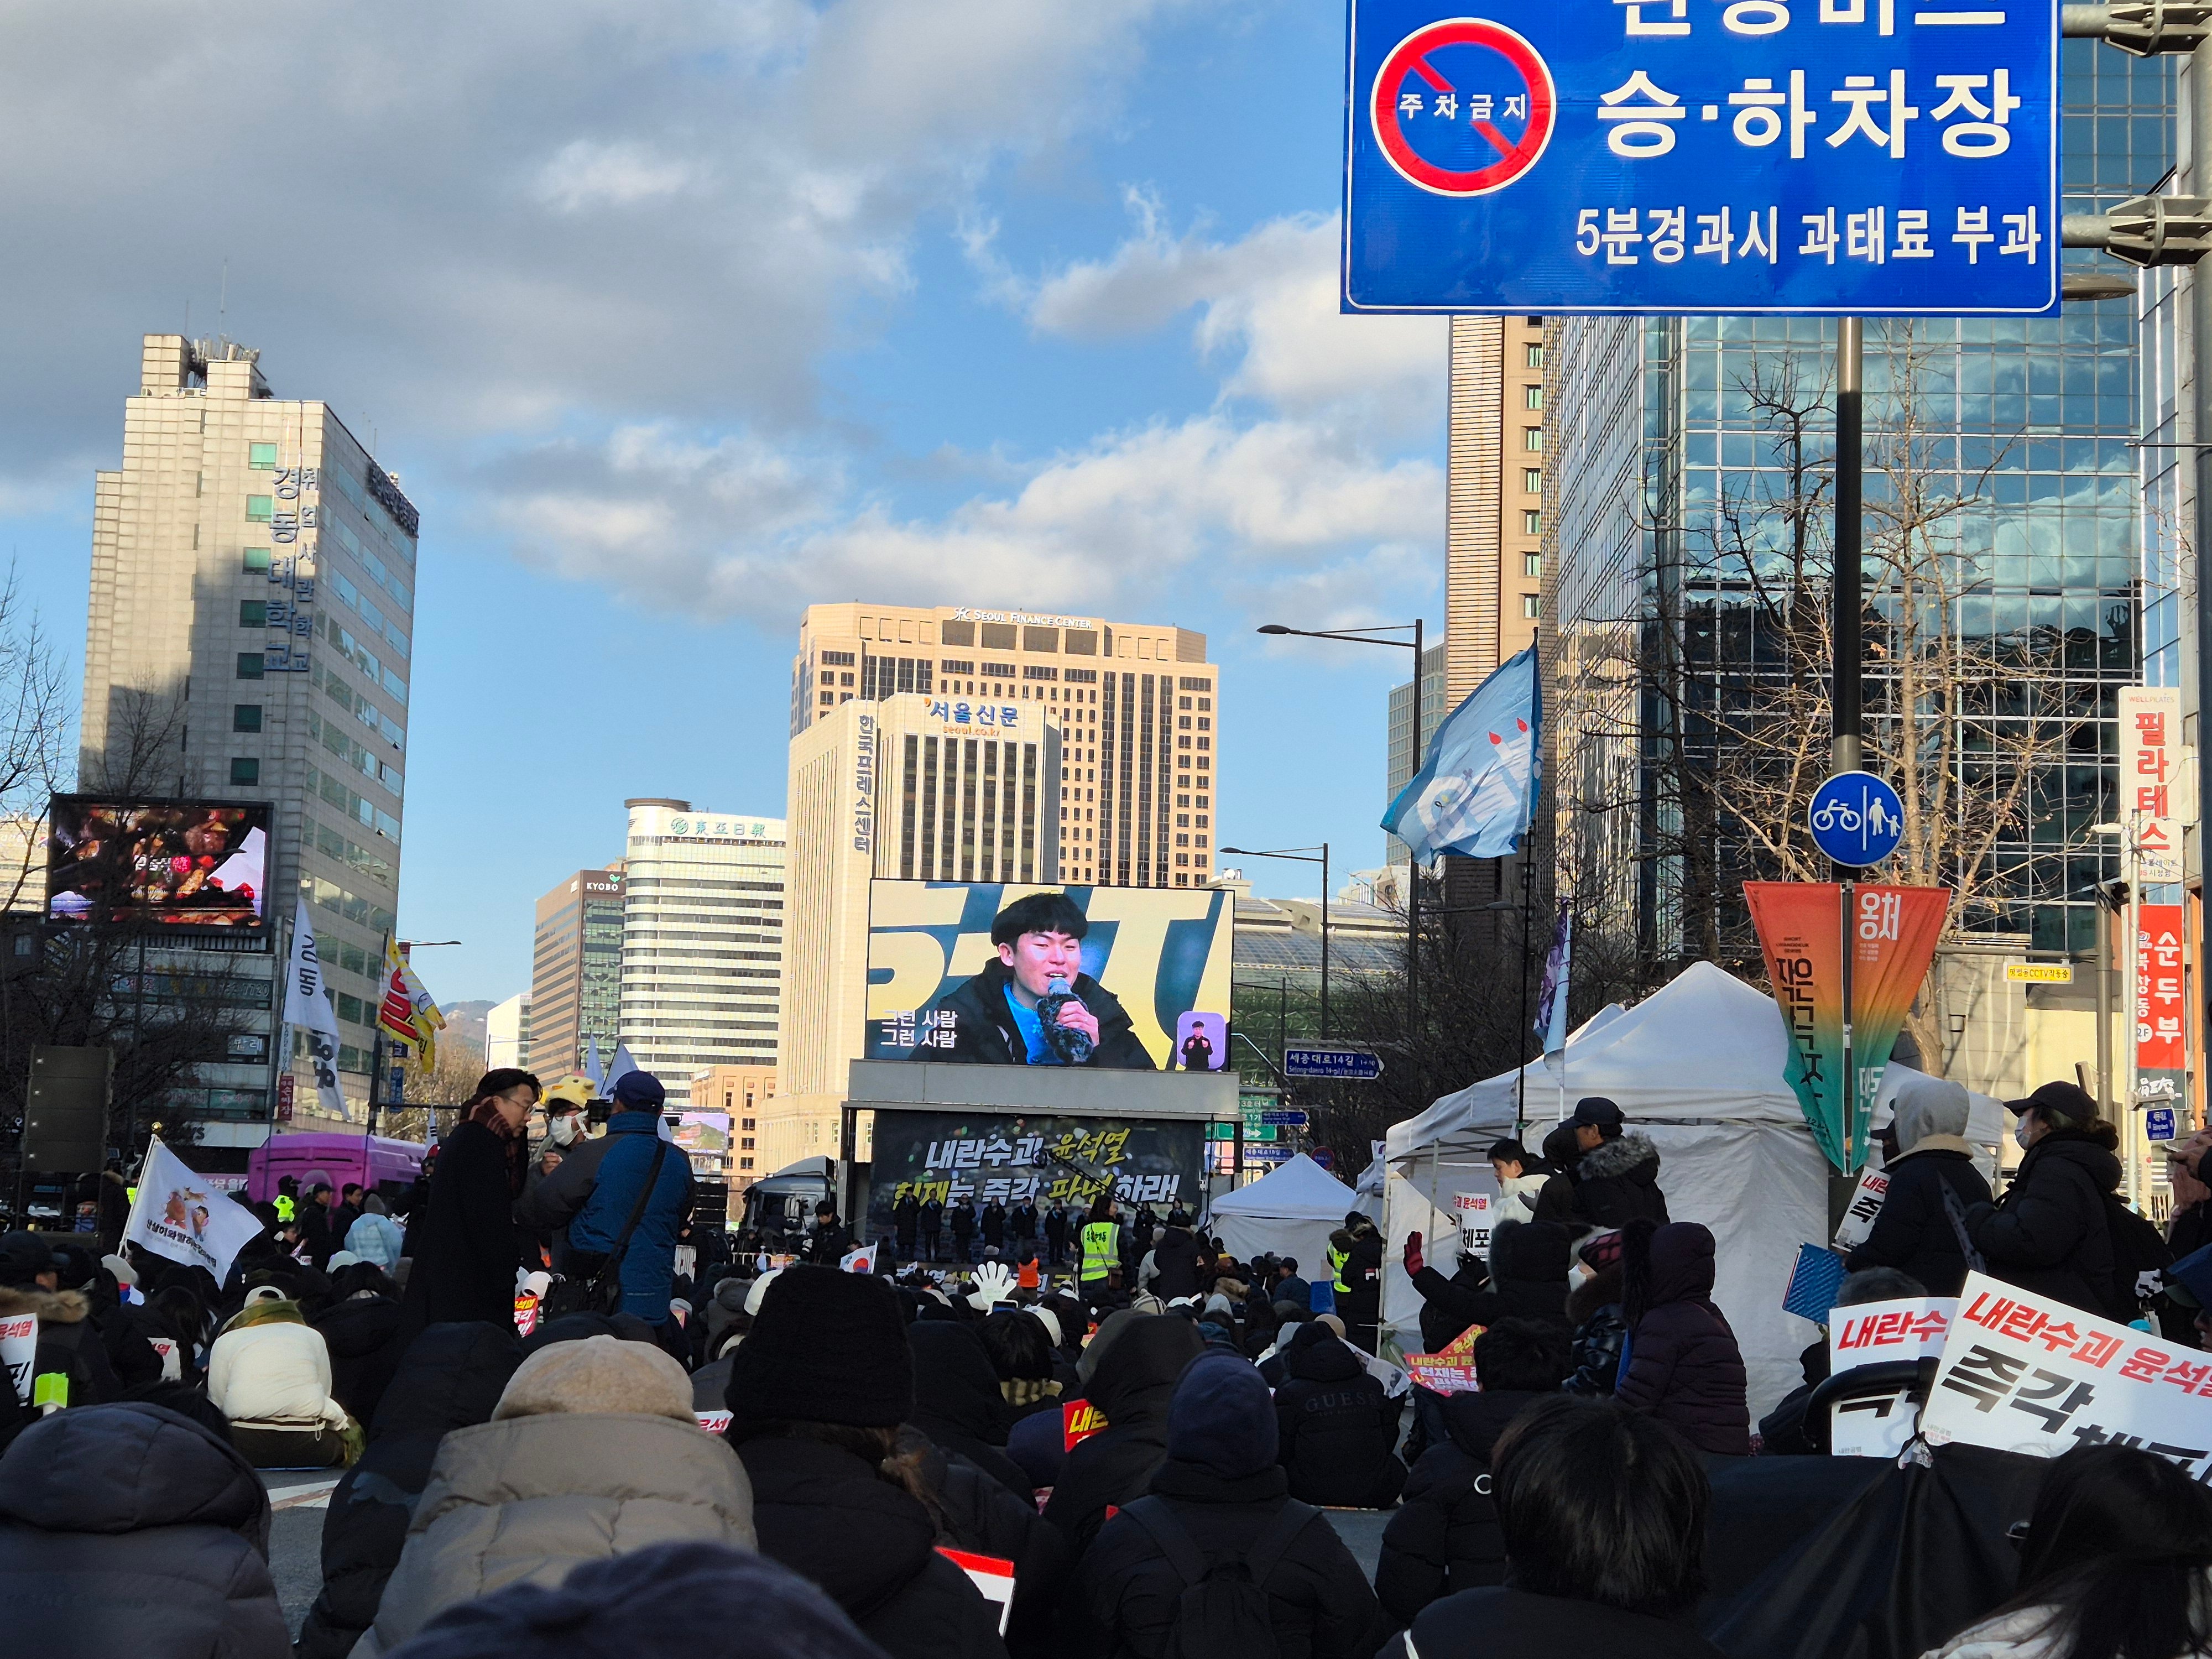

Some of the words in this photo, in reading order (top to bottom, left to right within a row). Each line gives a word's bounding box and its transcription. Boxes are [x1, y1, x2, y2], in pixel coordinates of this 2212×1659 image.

[1597, 67, 2021, 159] 승·하차장
[1575, 206, 1779, 266] 5분경과시
[1799, 206, 1936, 266] 과태료
[1952, 206, 2041, 266] 부과
[264, 466, 301, 672] 경동대학교
[289, 467, 321, 671] 취업사관학교
[930, 701, 1019, 728] 서울신문
[943, 726, 1000, 737] seoul.co.kr
[854, 715, 875, 855] 한국프레스센터
[2136, 712, 2170, 850] 필라테스
[695, 819, 766, 838] 東亞日報
[586, 881, 619, 892] KYOBO
[2154, 931, 2182, 1045] 순두부
[881, 1009, 916, 1027] 그런
[921, 1010, 958, 1028] 사람
[880, 1029, 915, 1047] 그런
[920, 1030, 957, 1048] 사람
[1290, 1053, 1354, 1066] 세종대로14길
[925, 1137, 1044, 1169] 내란수괴
[1051, 1127, 1131, 1165] 윤석열
[982, 1177, 1041, 1207] 즉각
[1463, 1197, 1487, 1210] 윤석열
[1462, 1227, 1490, 1248] 체포
[1837, 1310, 1949, 1350] 내란수
[1961, 1291, 2125, 1369] 내란수괴
[2117, 1347, 2212, 1399] 윤석
[1411, 1356, 1458, 1366] 내란수괴
[1418, 1366, 1465, 1379] 헌재는
[1940, 1344, 2097, 1434] 즉각
